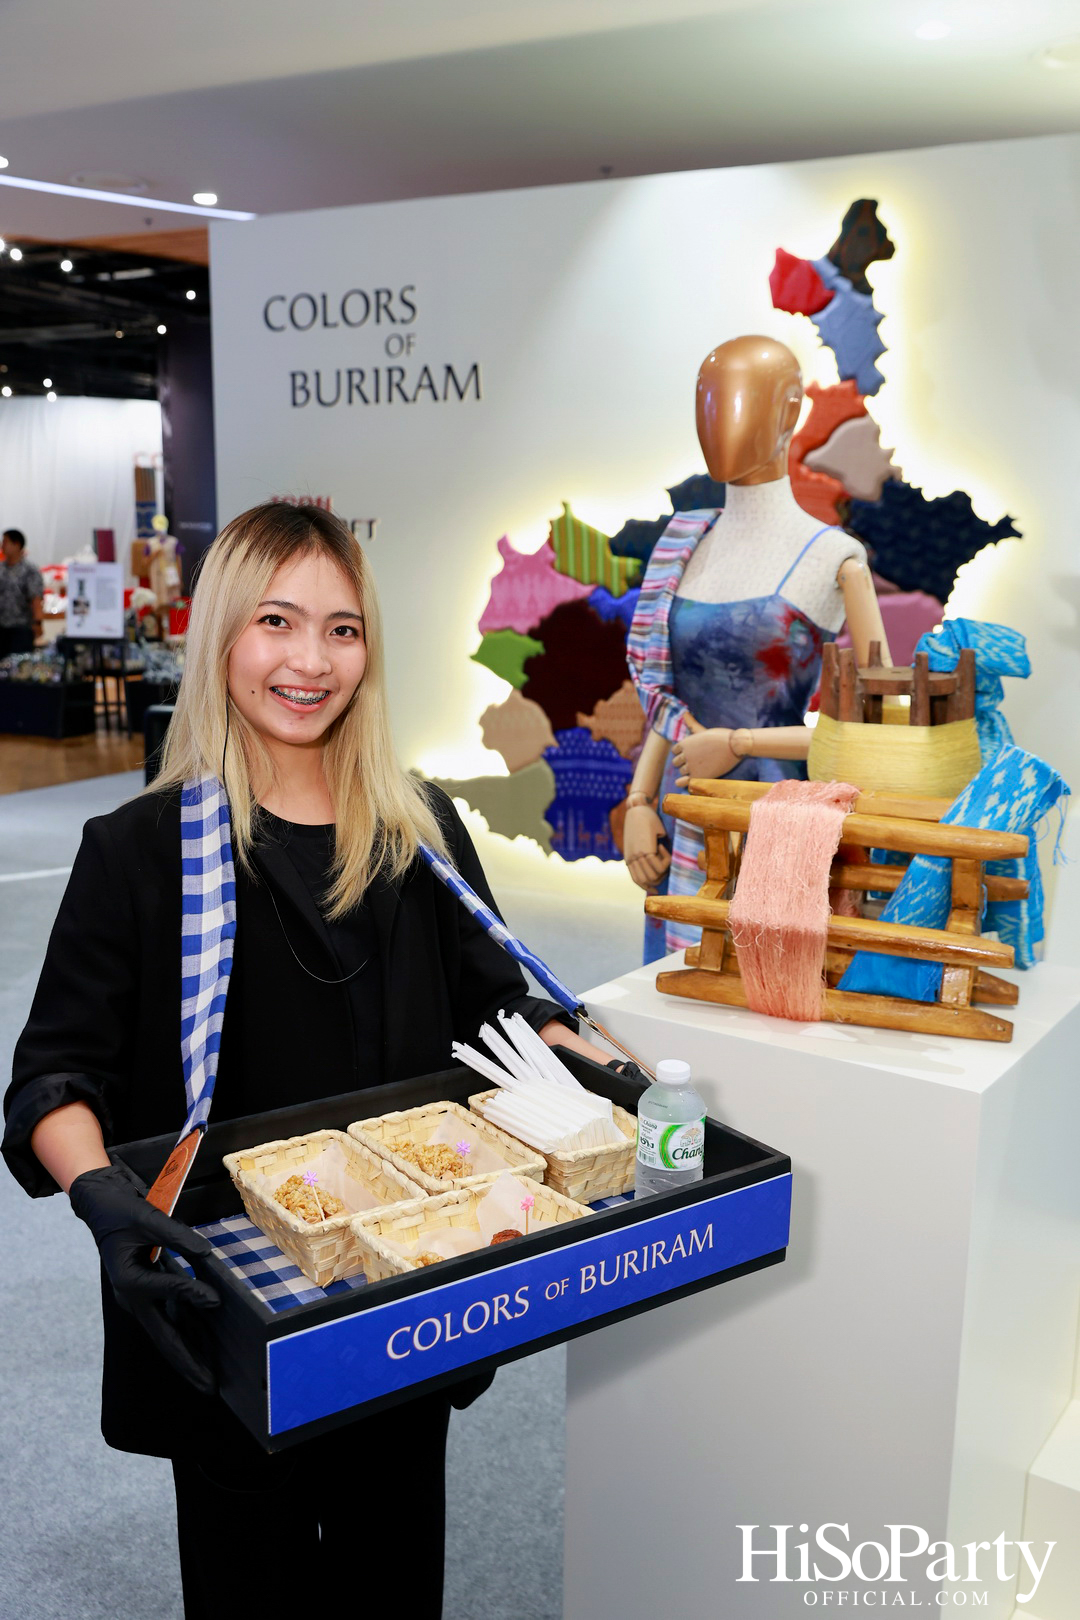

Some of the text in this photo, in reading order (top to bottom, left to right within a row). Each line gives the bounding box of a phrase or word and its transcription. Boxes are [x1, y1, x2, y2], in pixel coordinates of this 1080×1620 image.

[263, 285, 418, 332] COLORS
[384, 333, 417, 358] OF
[289, 362, 483, 408] BURIRAM
[386, 1223, 715, 1361] COLORS OF BURIRAM
